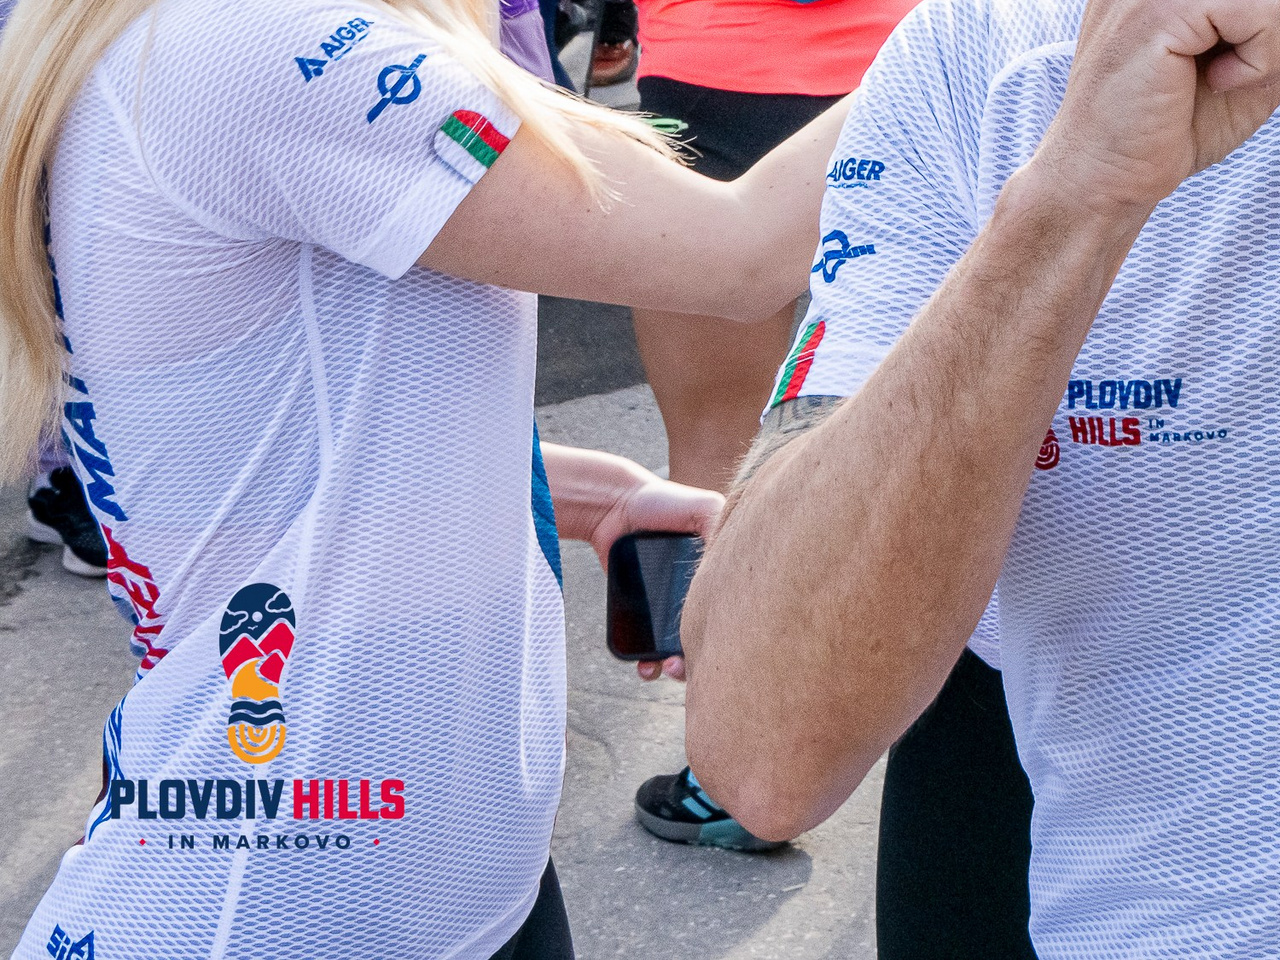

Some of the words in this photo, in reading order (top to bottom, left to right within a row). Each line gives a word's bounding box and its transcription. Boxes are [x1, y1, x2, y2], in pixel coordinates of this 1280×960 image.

[1067, 378, 1183, 410] PLOVDIV
[1068, 416, 1142, 447] HILLS
[1149, 418, 1165, 429] IN
[1149, 429, 1228, 443] MARKOVO
